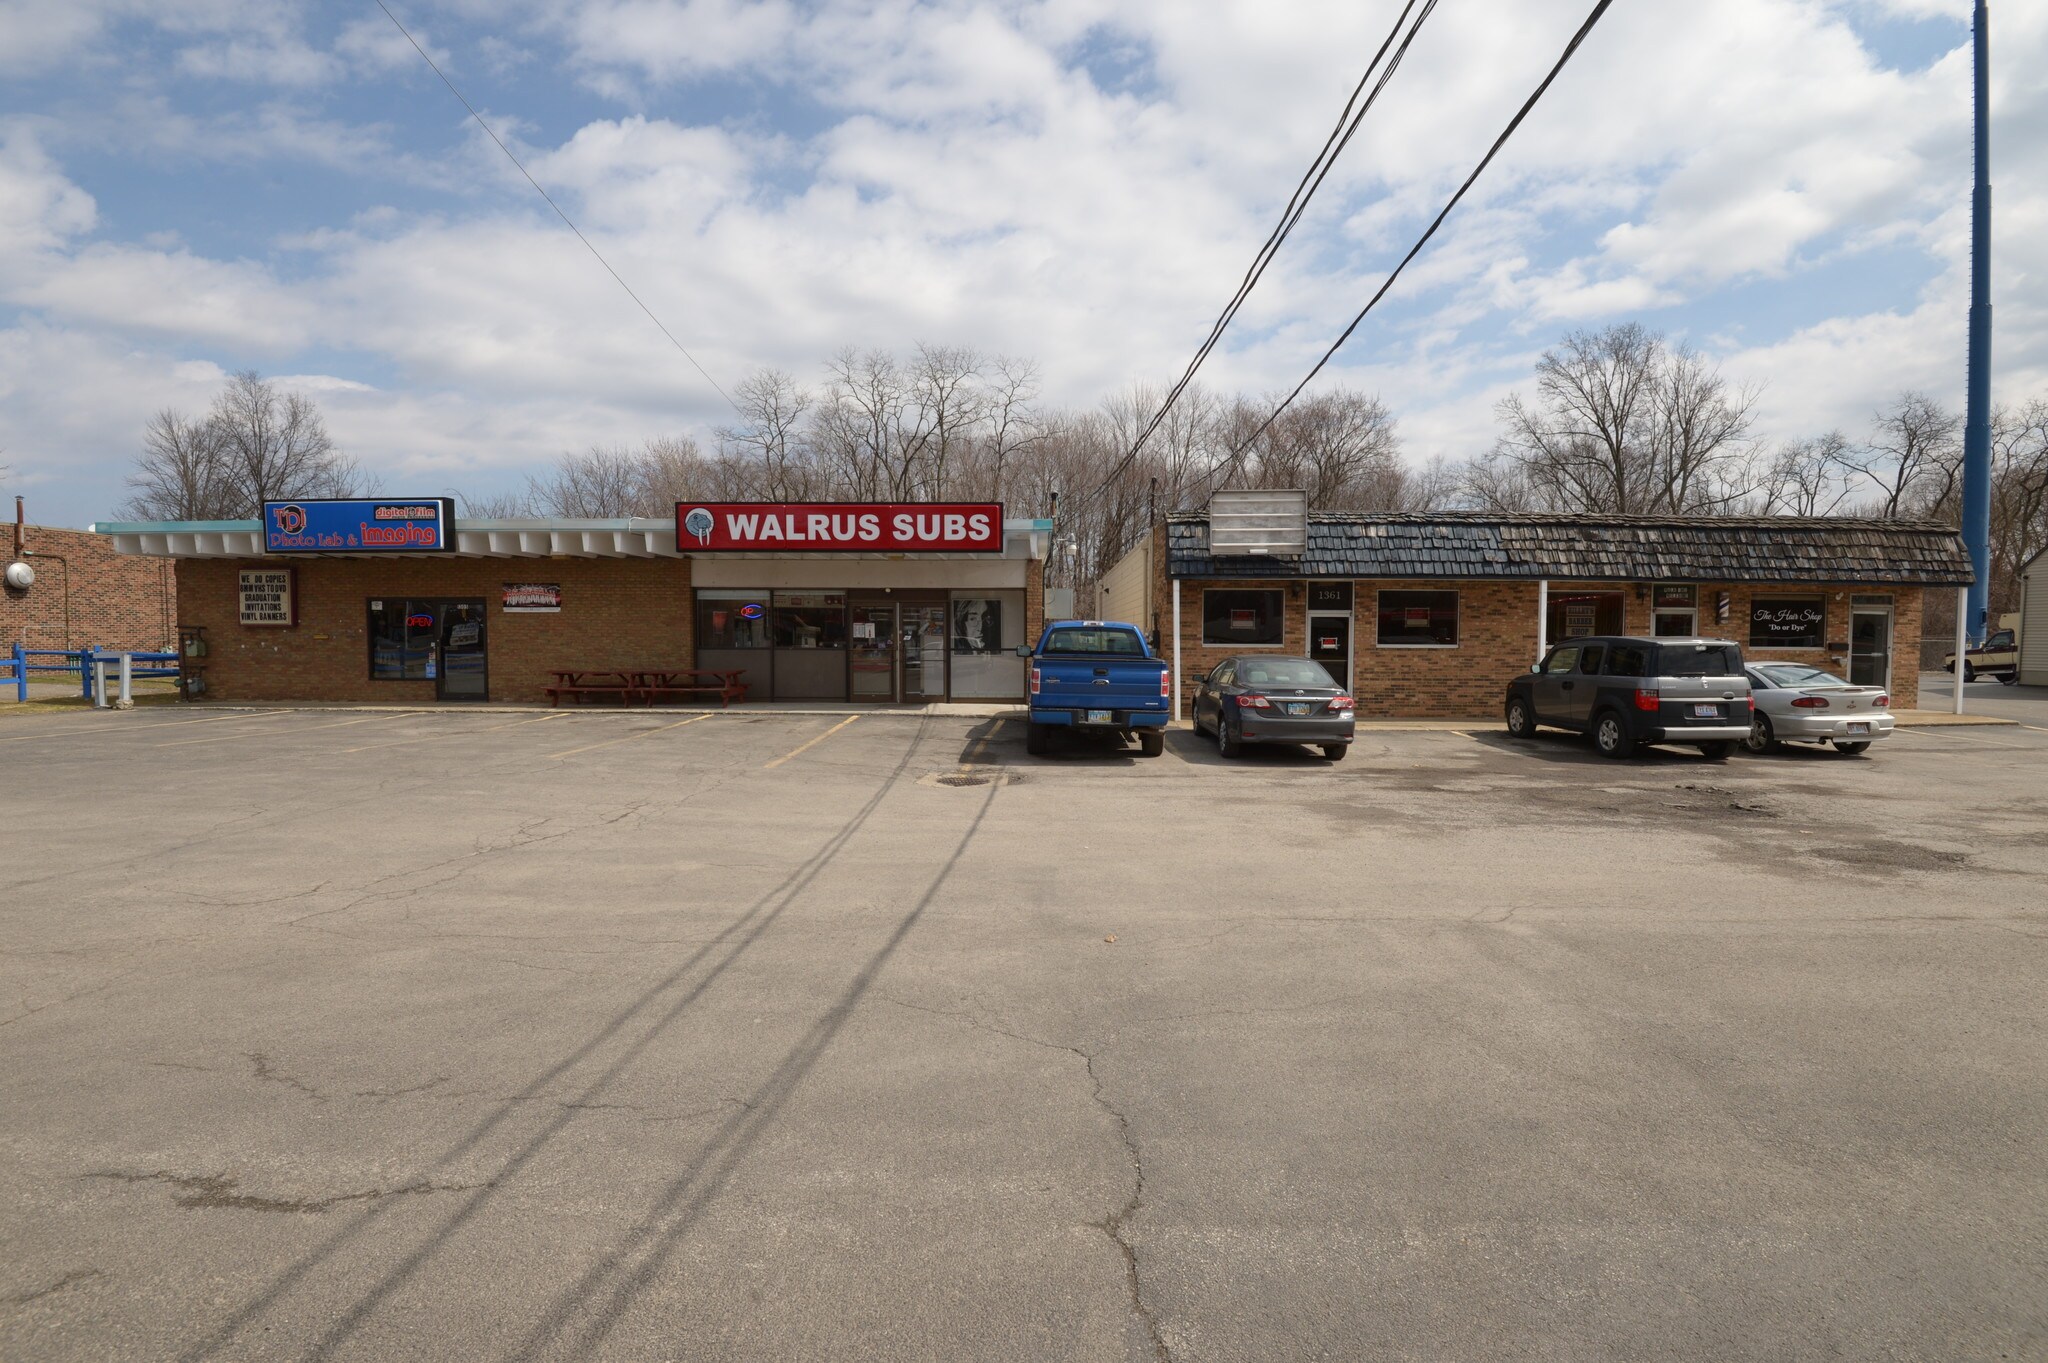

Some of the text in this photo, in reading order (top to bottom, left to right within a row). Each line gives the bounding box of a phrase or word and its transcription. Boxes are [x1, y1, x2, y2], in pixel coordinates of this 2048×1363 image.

[376, 507, 407, 519] digital
[415, 506, 435, 516] film
[726, 514, 990, 541] WALRUS SUBS
[271, 522, 436, 546] Photo Lab & imaging
[241, 575, 286, 583] WE DO COPIES
[245, 594, 281, 602] GRADUATION
[1319, 591, 1341, 600] 1361
[245, 603, 281, 611] INVITATIONS
[1753, 608, 1823, 623] The Hair Shop
[406, 617, 433, 627] OPEN
[1571, 628, 1589, 636] SHOP
